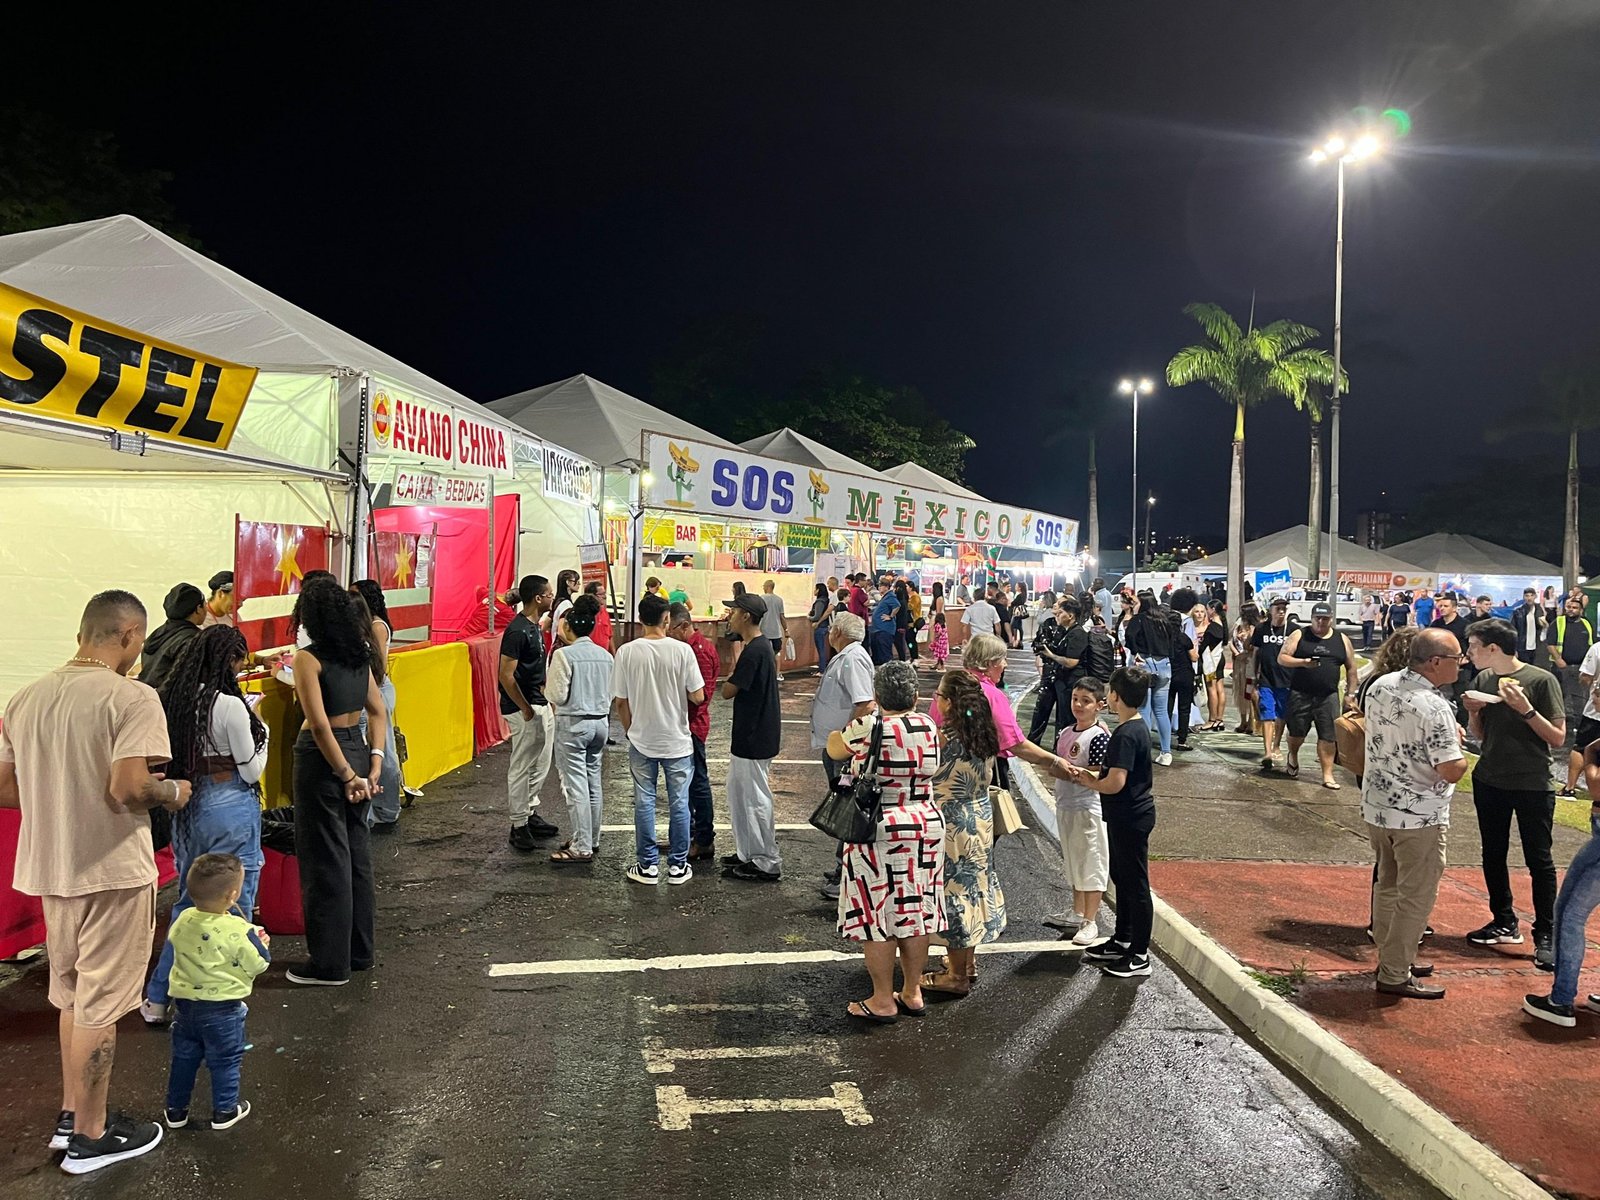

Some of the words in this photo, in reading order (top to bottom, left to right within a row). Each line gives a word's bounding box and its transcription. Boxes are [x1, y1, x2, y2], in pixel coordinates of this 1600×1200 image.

[0, 308, 224, 443] STEL
[393, 399, 452, 461] AVANO
[458, 419, 507, 470] CHINA
[396, 474, 434, 500] CAIXA
[445, 479, 485, 503] BEBIDAS
[711, 458, 795, 515] SOS
[845, 487, 1012, 544] MÉXICO
[1034, 518, 1063, 548] SOS
[676, 525, 697, 542] BAR
[801, 537, 821, 549] SABOR
